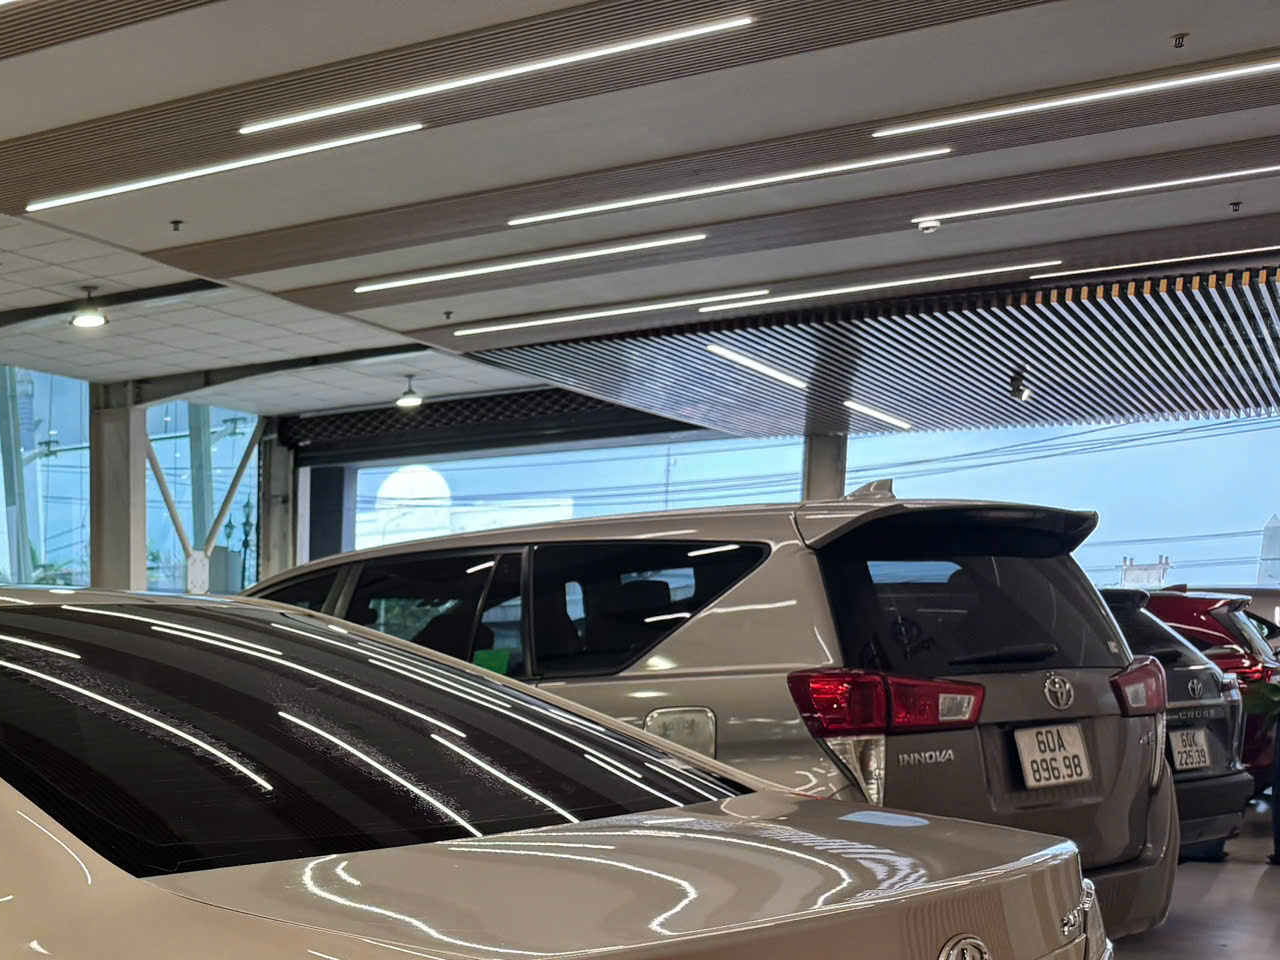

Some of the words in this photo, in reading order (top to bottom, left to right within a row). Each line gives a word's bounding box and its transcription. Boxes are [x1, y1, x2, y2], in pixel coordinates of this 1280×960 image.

[1035, 728, 1066, 754] 60A
[897, 749, 956, 767] INNOVA
[1030, 754, 1084, 783] 896.98
